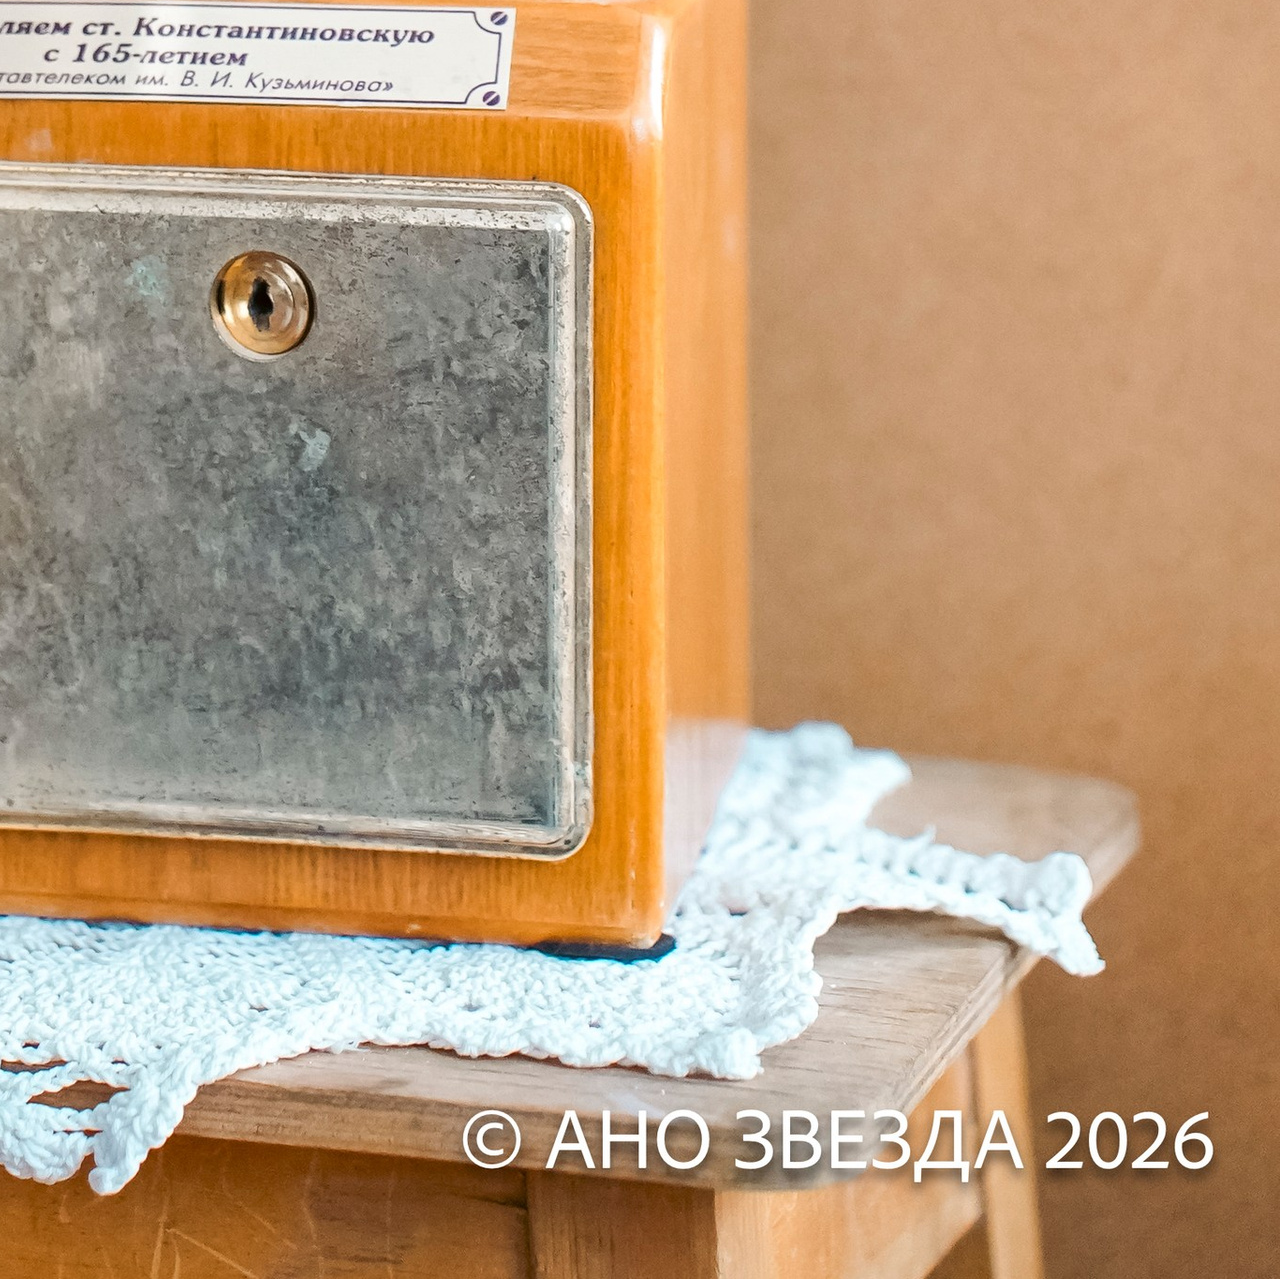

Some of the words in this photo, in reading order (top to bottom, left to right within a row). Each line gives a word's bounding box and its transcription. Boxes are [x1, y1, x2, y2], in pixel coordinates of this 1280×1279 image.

[82, 21, 121, 36] ст.
[132, 17, 436, 48] Константиновскую
[43, 48, 60, 63] с
[71, 42, 249, 67] 165-летием
[134, 74, 169, 87] им.
[180, 70, 199, 88] В.
[210, 72, 234, 89] И.
[244, 72, 395, 93] Кузьминова»
